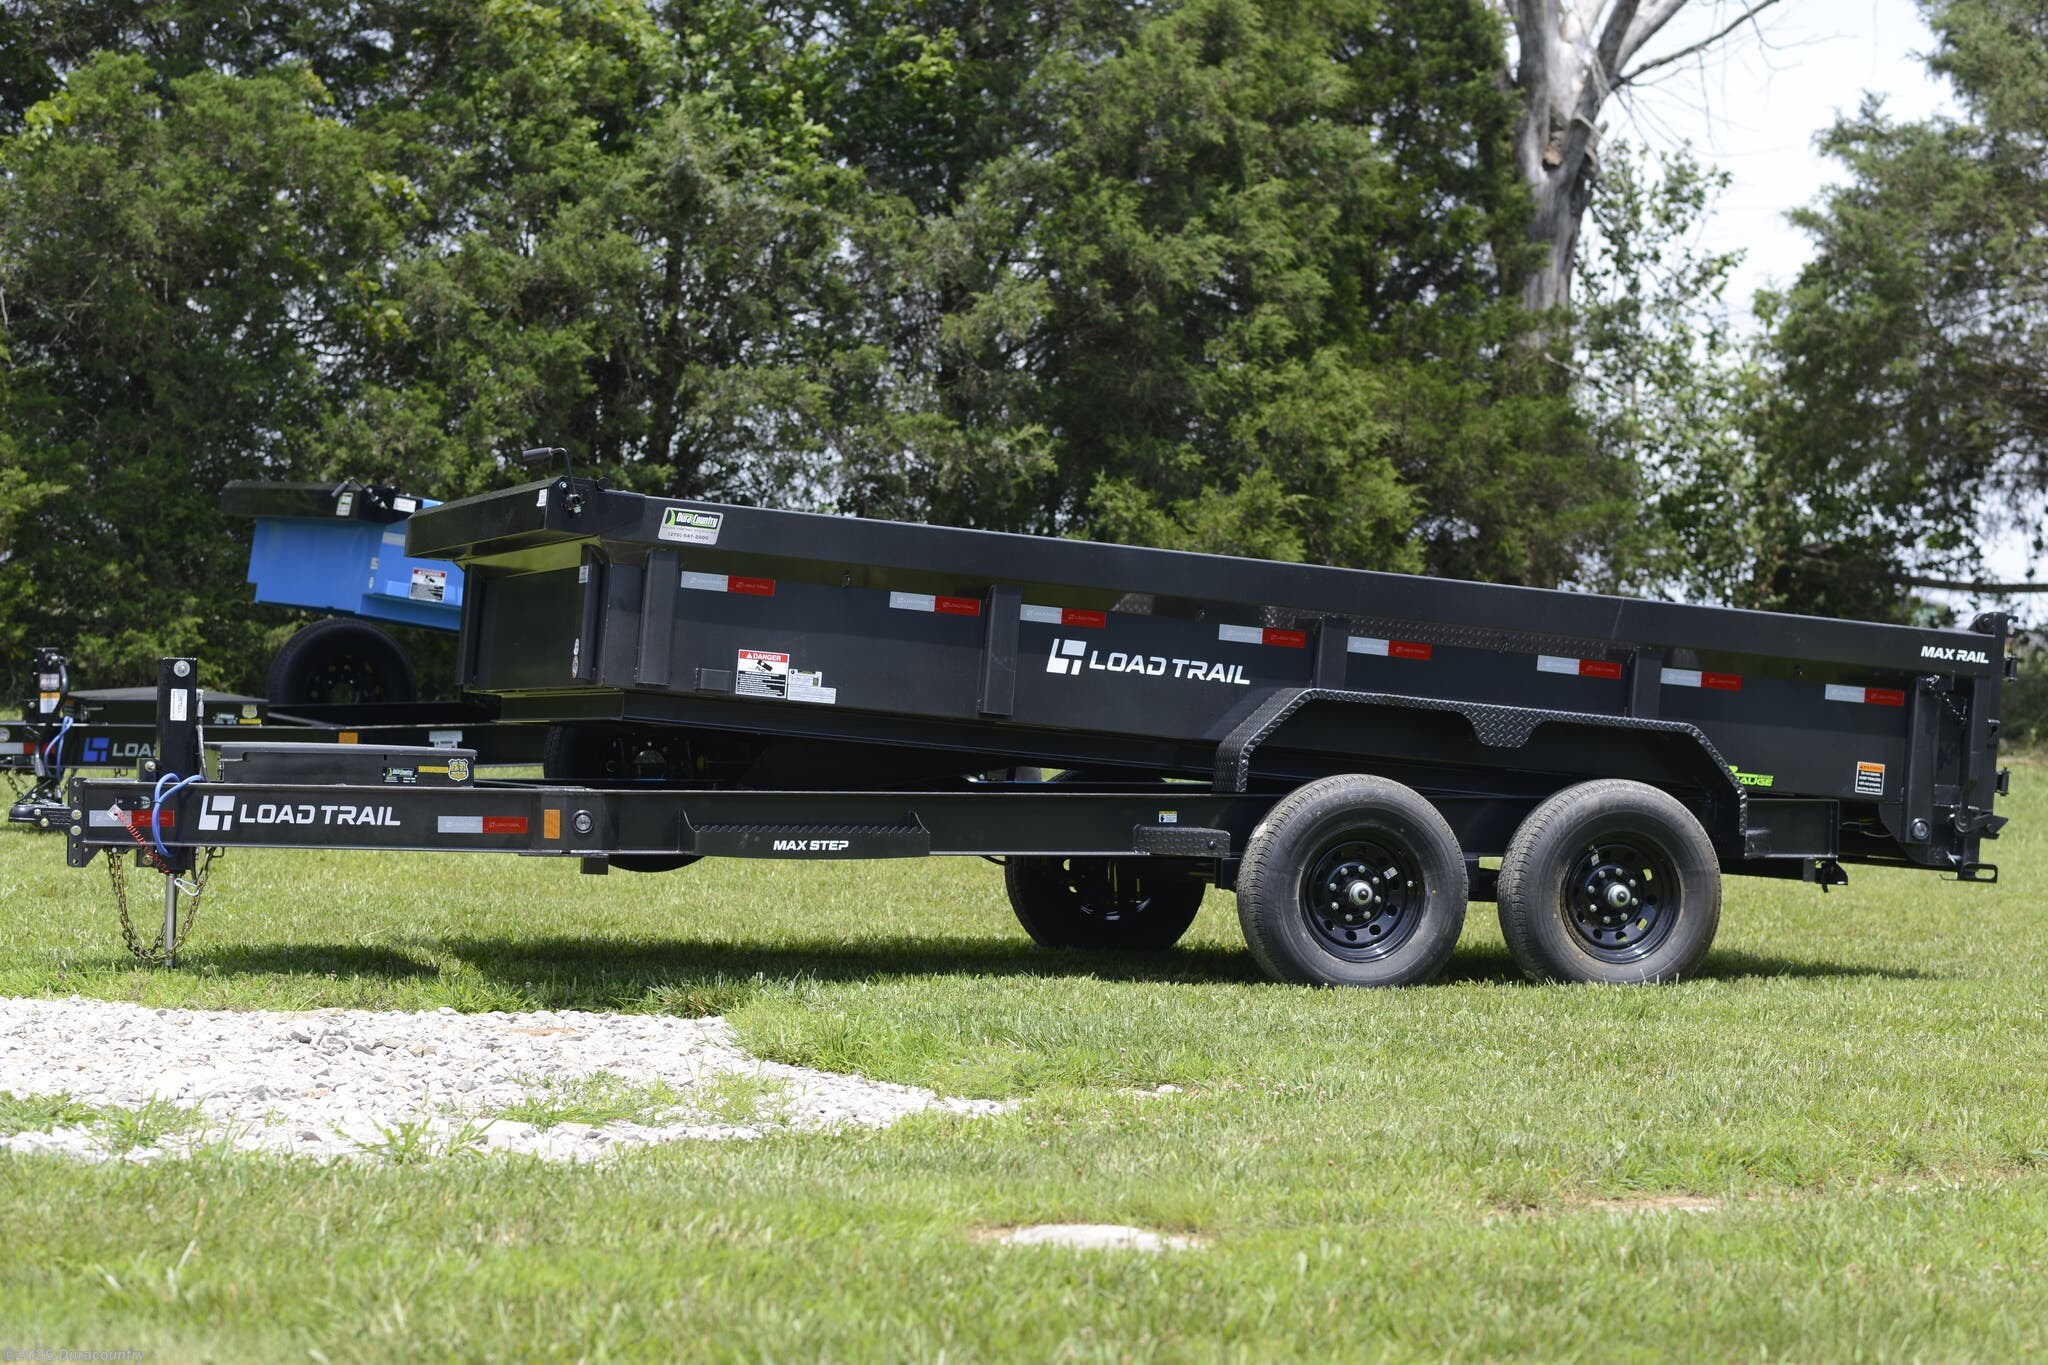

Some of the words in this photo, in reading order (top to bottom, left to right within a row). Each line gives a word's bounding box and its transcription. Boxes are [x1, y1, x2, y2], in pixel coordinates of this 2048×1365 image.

[676, 512, 692, 523] Dura
[693, 514, 719, 528] Country
[752, 652, 782, 662] DANGER
[1920, 645, 1955, 661] MAX
[1955, 648, 1989, 664] RAIL
[1089, 649, 1167, 676] LOAD
[1173, 658, 1251, 686] TRAIL
[112, 743, 157, 757] LOA
[1739, 776, 1773, 787] AUGE
[239, 804, 316, 824] LOAD
[321, 805, 401, 827] TRAIL
[773, 840, 807, 851] MAX
[809, 840, 849, 851] STEP
